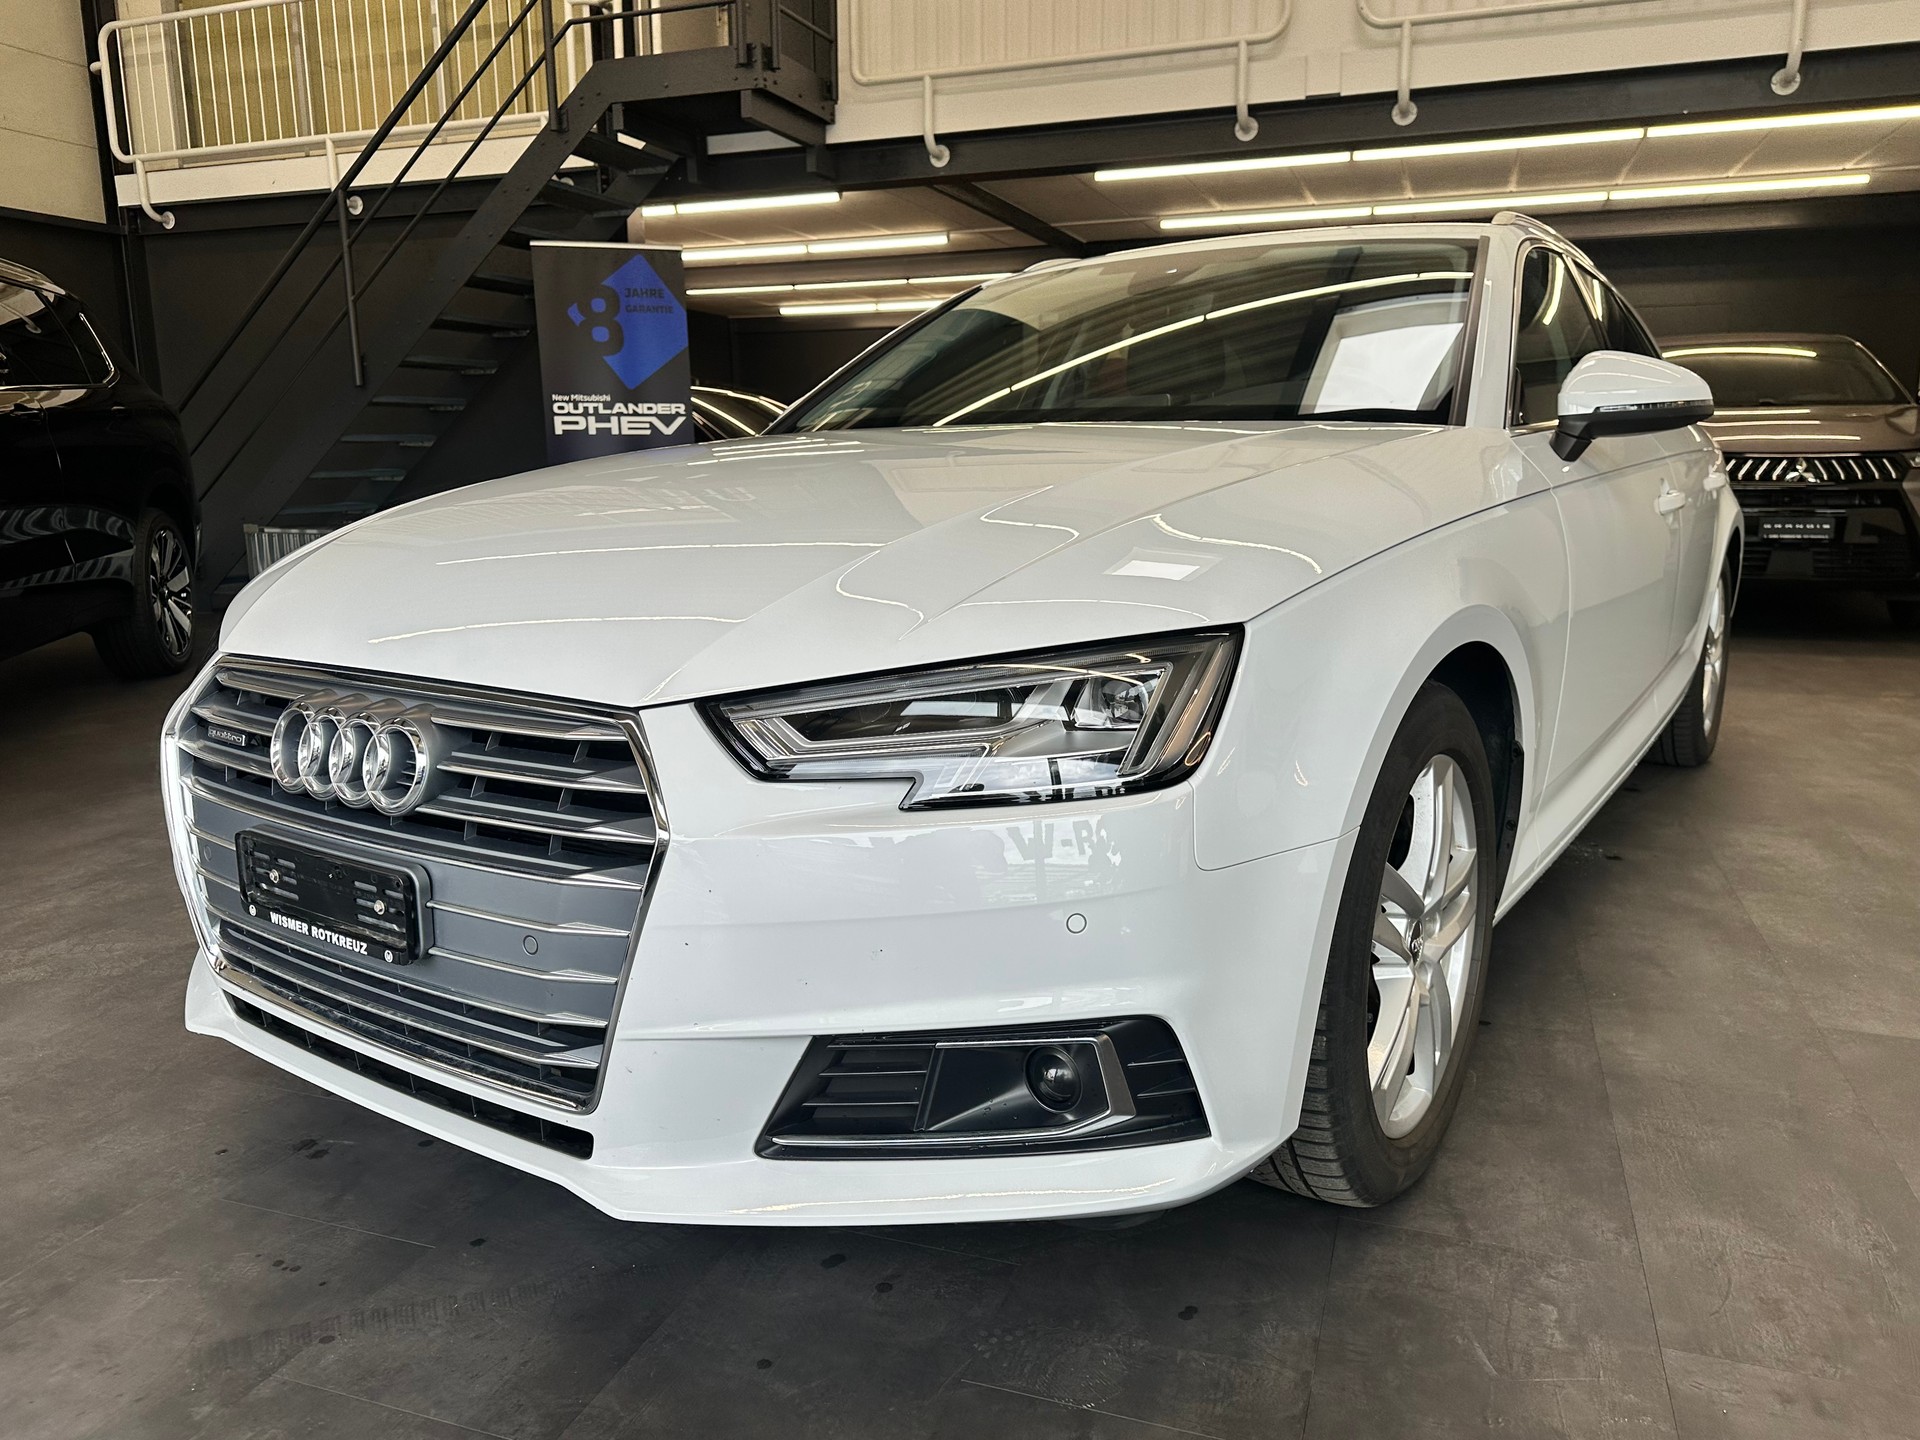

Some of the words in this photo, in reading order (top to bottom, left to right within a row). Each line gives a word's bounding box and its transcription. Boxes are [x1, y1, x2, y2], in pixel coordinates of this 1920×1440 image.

[625, 288, 665, 299] JAHRE
[625, 304, 674, 315] GARANTIE
[576, 287, 624, 356] 8
[552, 394, 569, 402] New
[571, 394, 611, 402] Mitsubishi
[553, 403, 687, 415] OUTLANDER
[553, 416, 687, 436] PHEV
[208, 728, 242, 743] quattro
[269, 911, 309, 936] WISMER
[311, 925, 368, 955] ROTKREUZ
